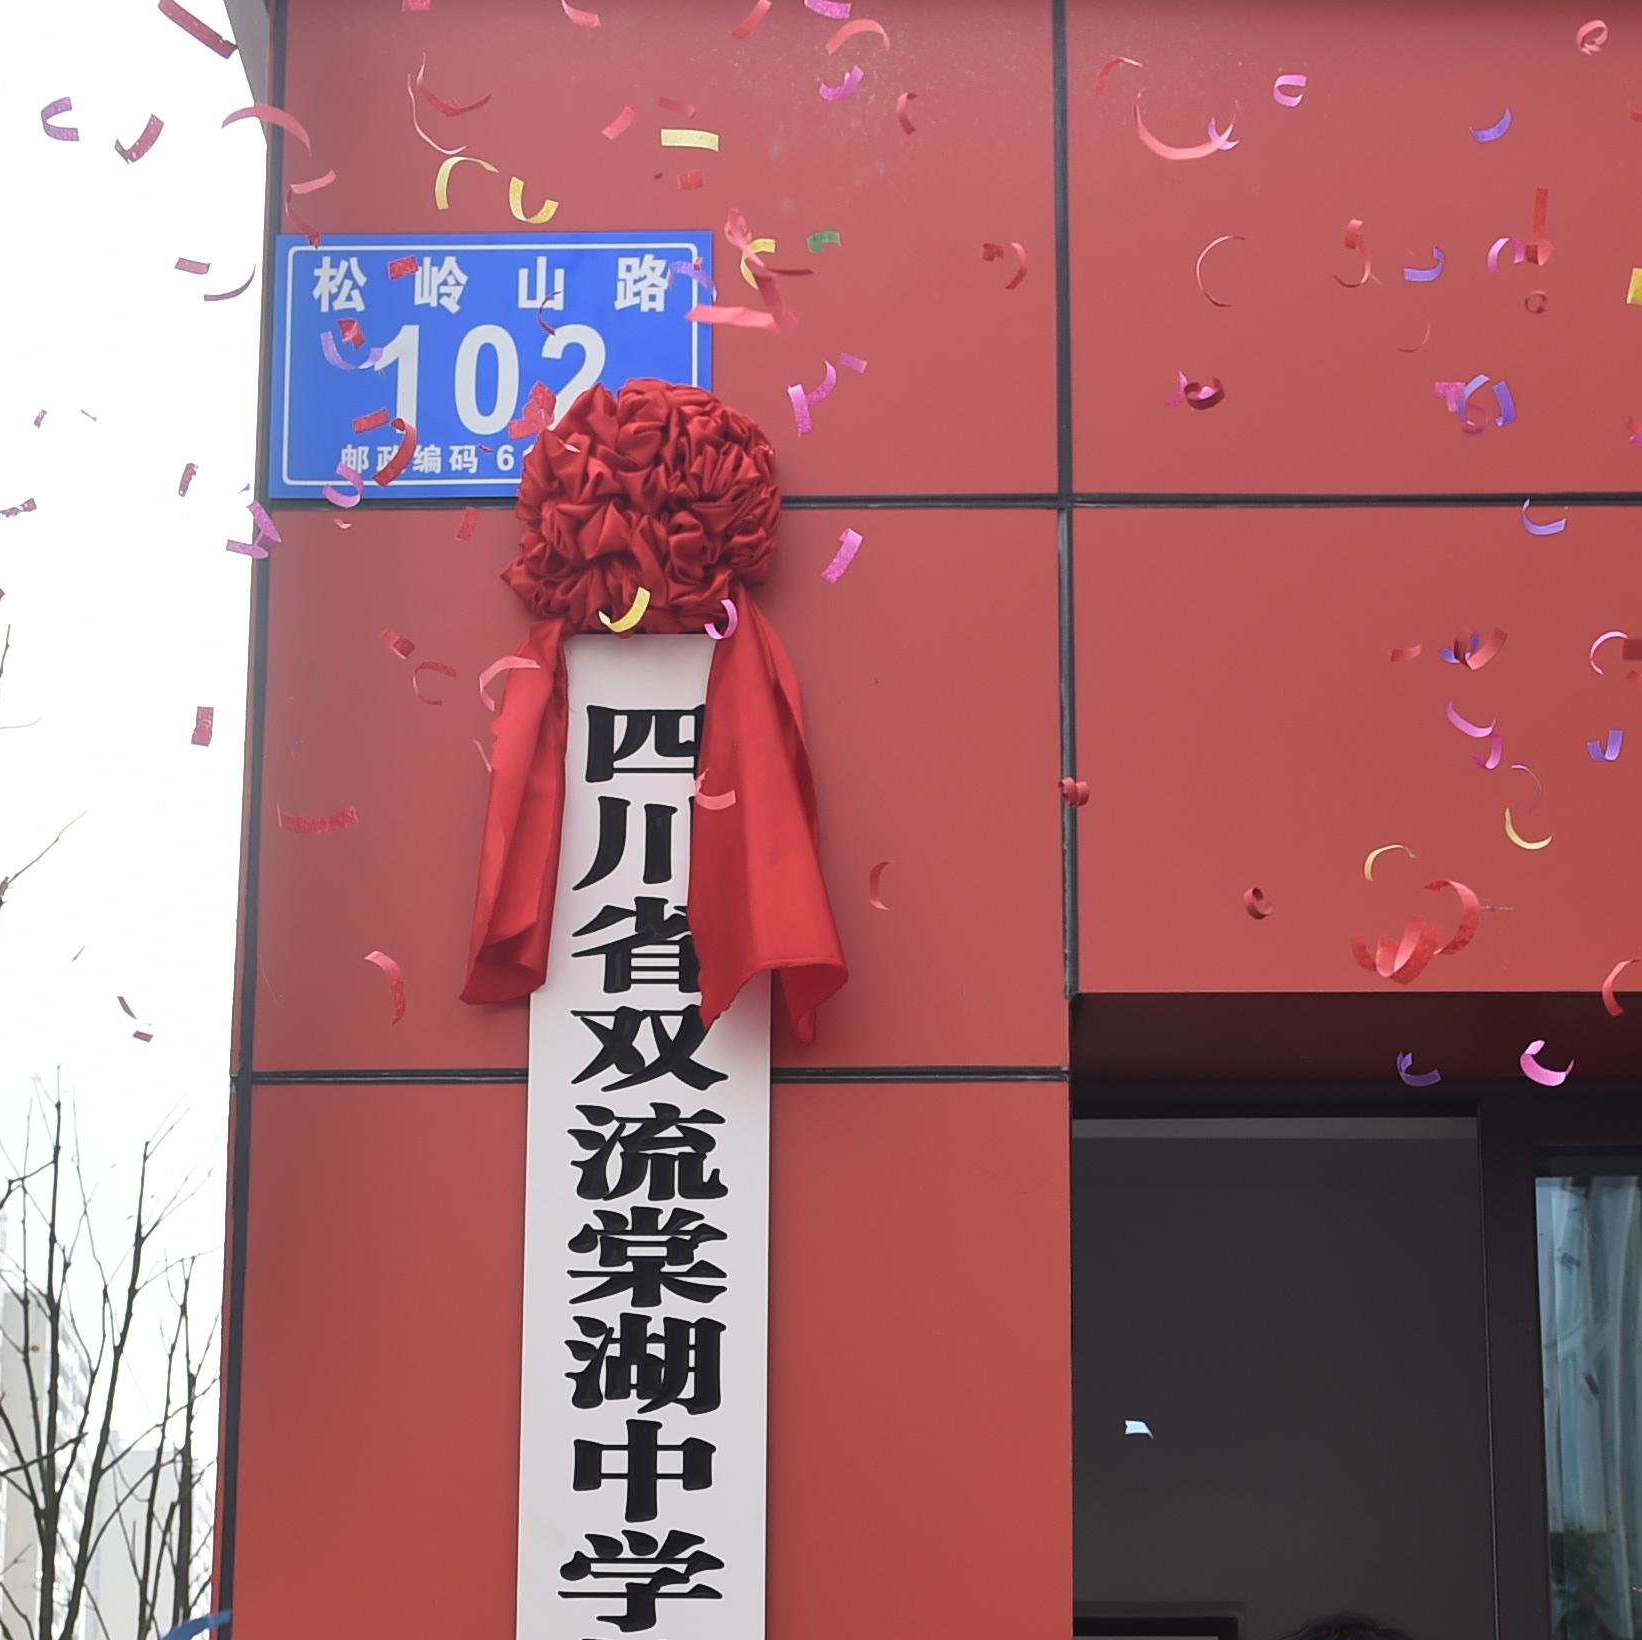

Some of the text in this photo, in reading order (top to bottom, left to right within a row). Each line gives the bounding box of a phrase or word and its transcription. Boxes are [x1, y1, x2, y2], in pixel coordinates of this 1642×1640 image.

[313, 255, 668, 314] 松岭山路
[375, 324, 606, 434] 102
